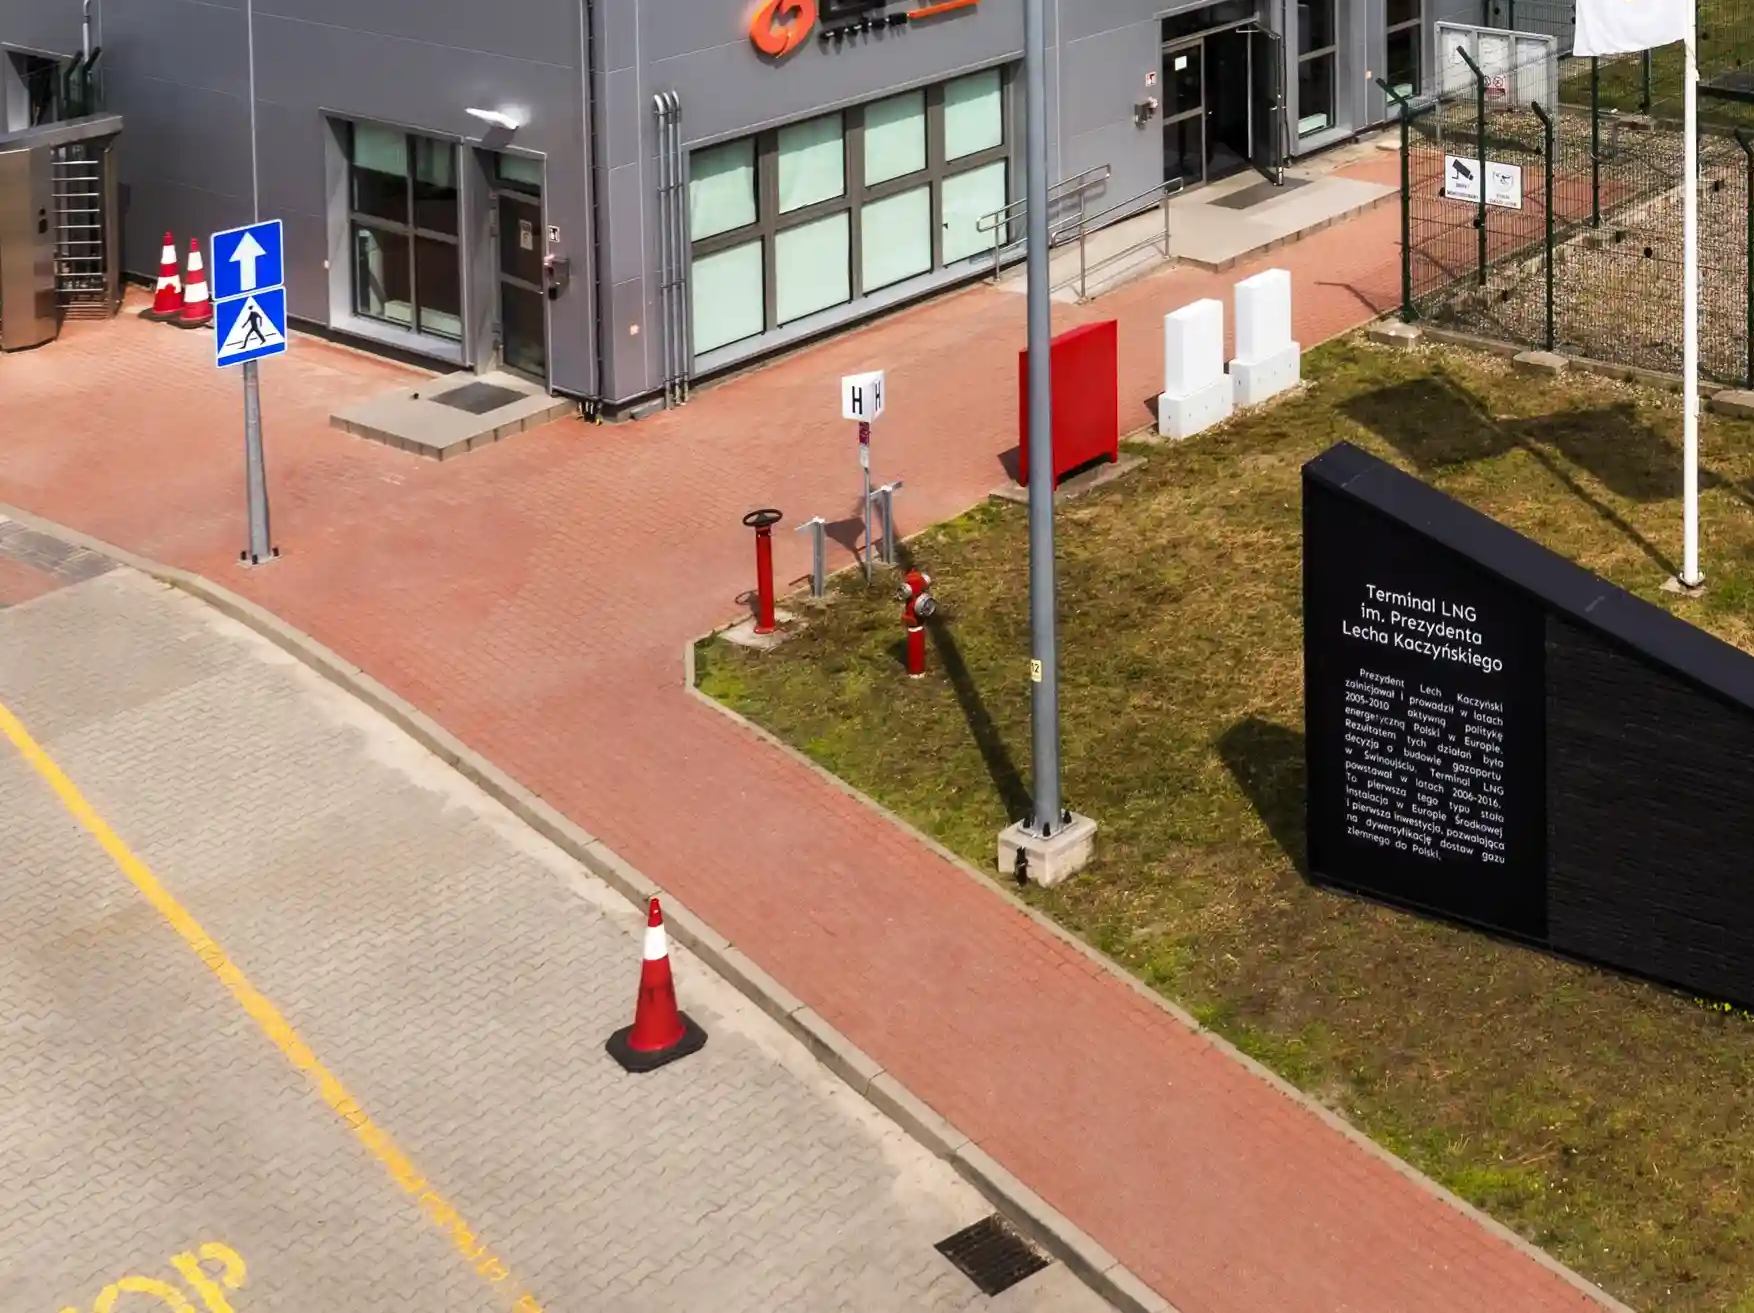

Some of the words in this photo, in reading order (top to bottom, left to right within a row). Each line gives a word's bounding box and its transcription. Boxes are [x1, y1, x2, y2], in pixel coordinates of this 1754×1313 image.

[852, 386, 862, 415] H
[875, 380, 881, 412] H
[1361, 602, 1385, 623] im.
[1391, 610, 1482, 644] Prezydenta
[1366, 584, 1436, 614] Terminal
[1442, 601, 1477, 622] LNG
[1342, 620, 1388, 644] Lecha
[1394, 632, 1502, 673] Kaczyńskiego
[1360, 668, 1404, 687] Prezydent
[1420, 684, 1442, 697] Lech
[1457, 693, 1503, 712] Kaczyński
[1409, 696, 1454, 714] prowadził
[1460, 709, 1468, 717] w
[1474, 710, 1503, 726] latach
[1345, 691, 1389, 710] 2005-2010
[1407, 709, 1446, 728] aktywną
[1465, 724, 1503, 742] politykę
[1345, 718, 1396, 739] Rezultatem
[1407, 735, 1427, 748] tych
[1437, 744, 1472, 759] działań
[1483, 755, 1504, 768] była
[1345, 733, 1379, 749] decyzja
[1387, 744, 1394, 752] o
[1403, 748, 1442, 765] budowie
[1452, 761, 1501, 780] gazoportu
[1345, 760, 1392, 779] powstawał
[1401, 775, 1408, 783] w
[1416, 778, 1444, 794] latach
[1452, 788, 1502, 809] 2006-2016.
[1346, 772, 1357, 782] To
[1367, 779, 1406, 797] pierwsza
[1418, 793, 1439, 806] tego
[1449, 802, 1470, 815] typu
[1481, 810, 1504, 823] stała
[1430, 768, 1471, 786] Terminal
[1483, 783, 1504, 795] LNG
[1346, 786, 1388, 805] instalacja
[1396, 801, 1404, 809] w
[1412, 804, 1447, 821] Europie
[1455, 816, 1503, 839] Środkowej
[1352, 802, 1391, 819] pierwsza
[1447, 828, 1505, 851] pozwalająca
[1346, 813, 1358, 822] na
[1366, 819, 1432, 845] dywersyfikację
[1440, 840, 1474, 856] dostaw
[1482, 851, 1504, 864] gazu
[1347, 826, 1390, 846] ziemnego
[1395, 840, 1407, 851] do
[1412, 844, 1441, 861] Polski.
